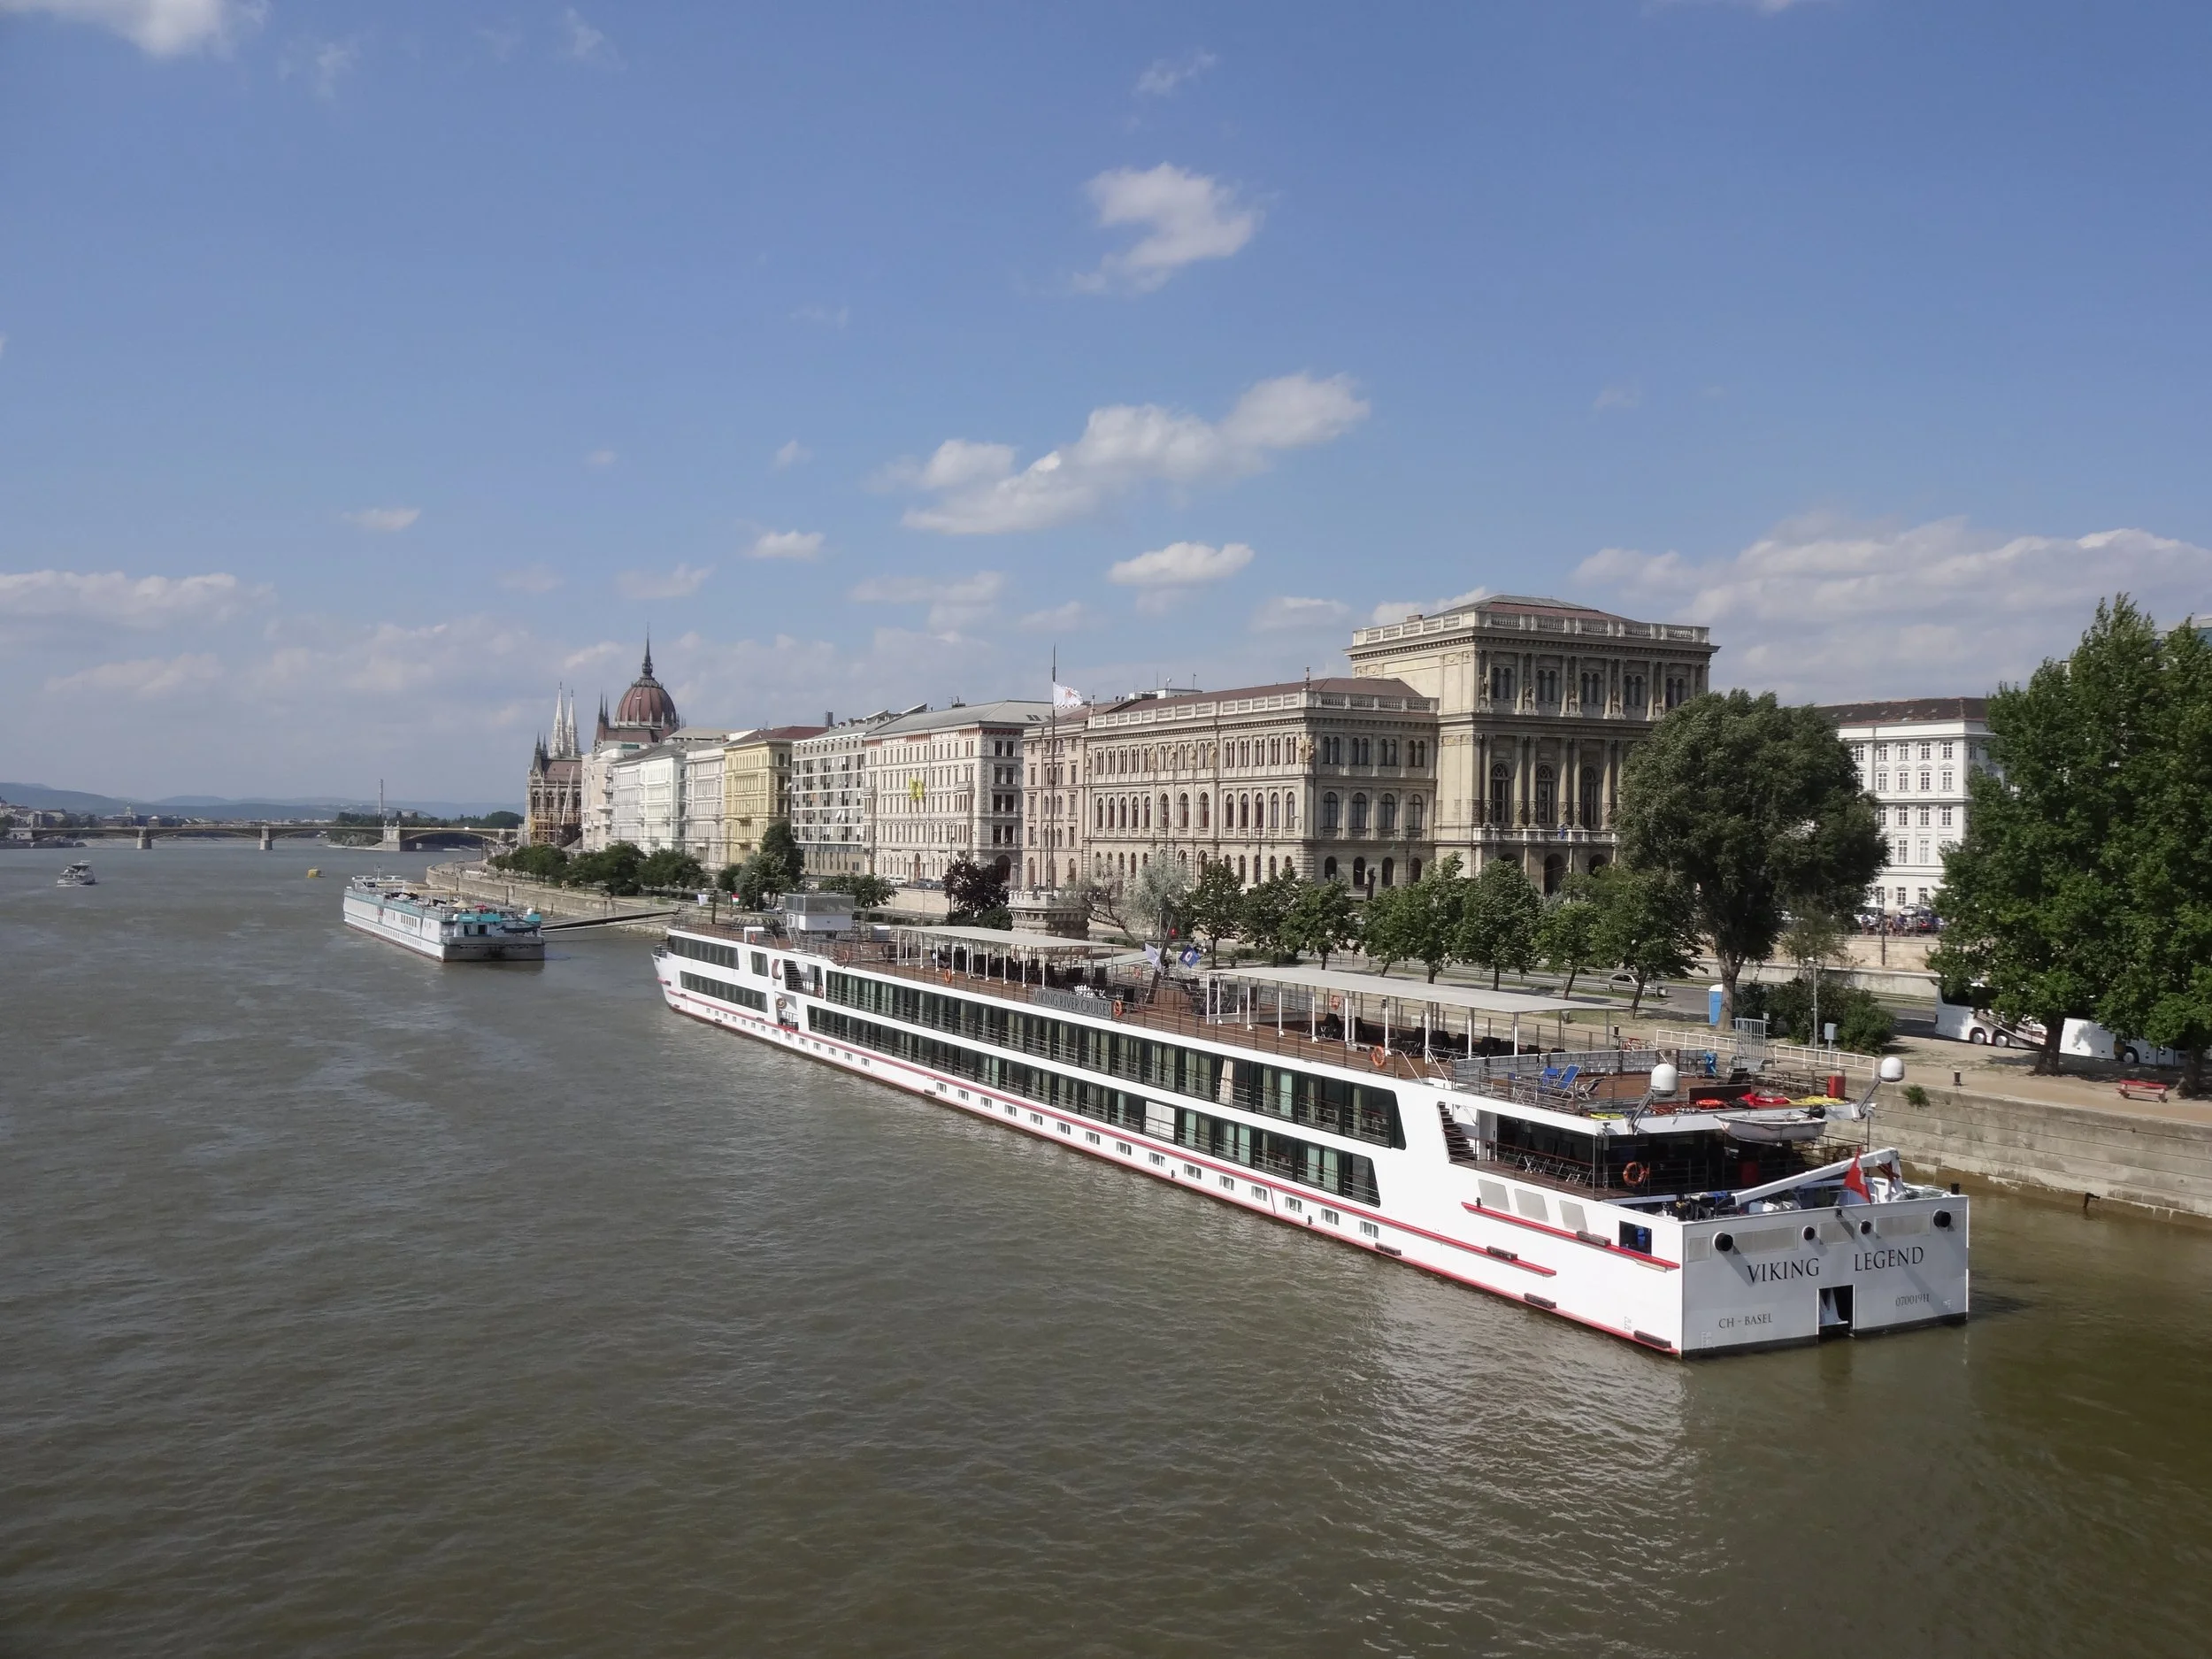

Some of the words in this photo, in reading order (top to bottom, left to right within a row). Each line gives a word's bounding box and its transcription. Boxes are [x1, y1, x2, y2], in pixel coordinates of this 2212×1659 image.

[1033, 989, 1058, 1007] VIKING
[1059, 995, 1079, 1010] RIVER
[1080, 999, 1110, 1018] CRUISES
[1747, 1257, 1819, 1283] VIKING
[1855, 1246, 1924, 1271] LEGEND
[1718, 1317, 1734, 1329] CH
[1744, 1312, 1773, 1326] BASEL
